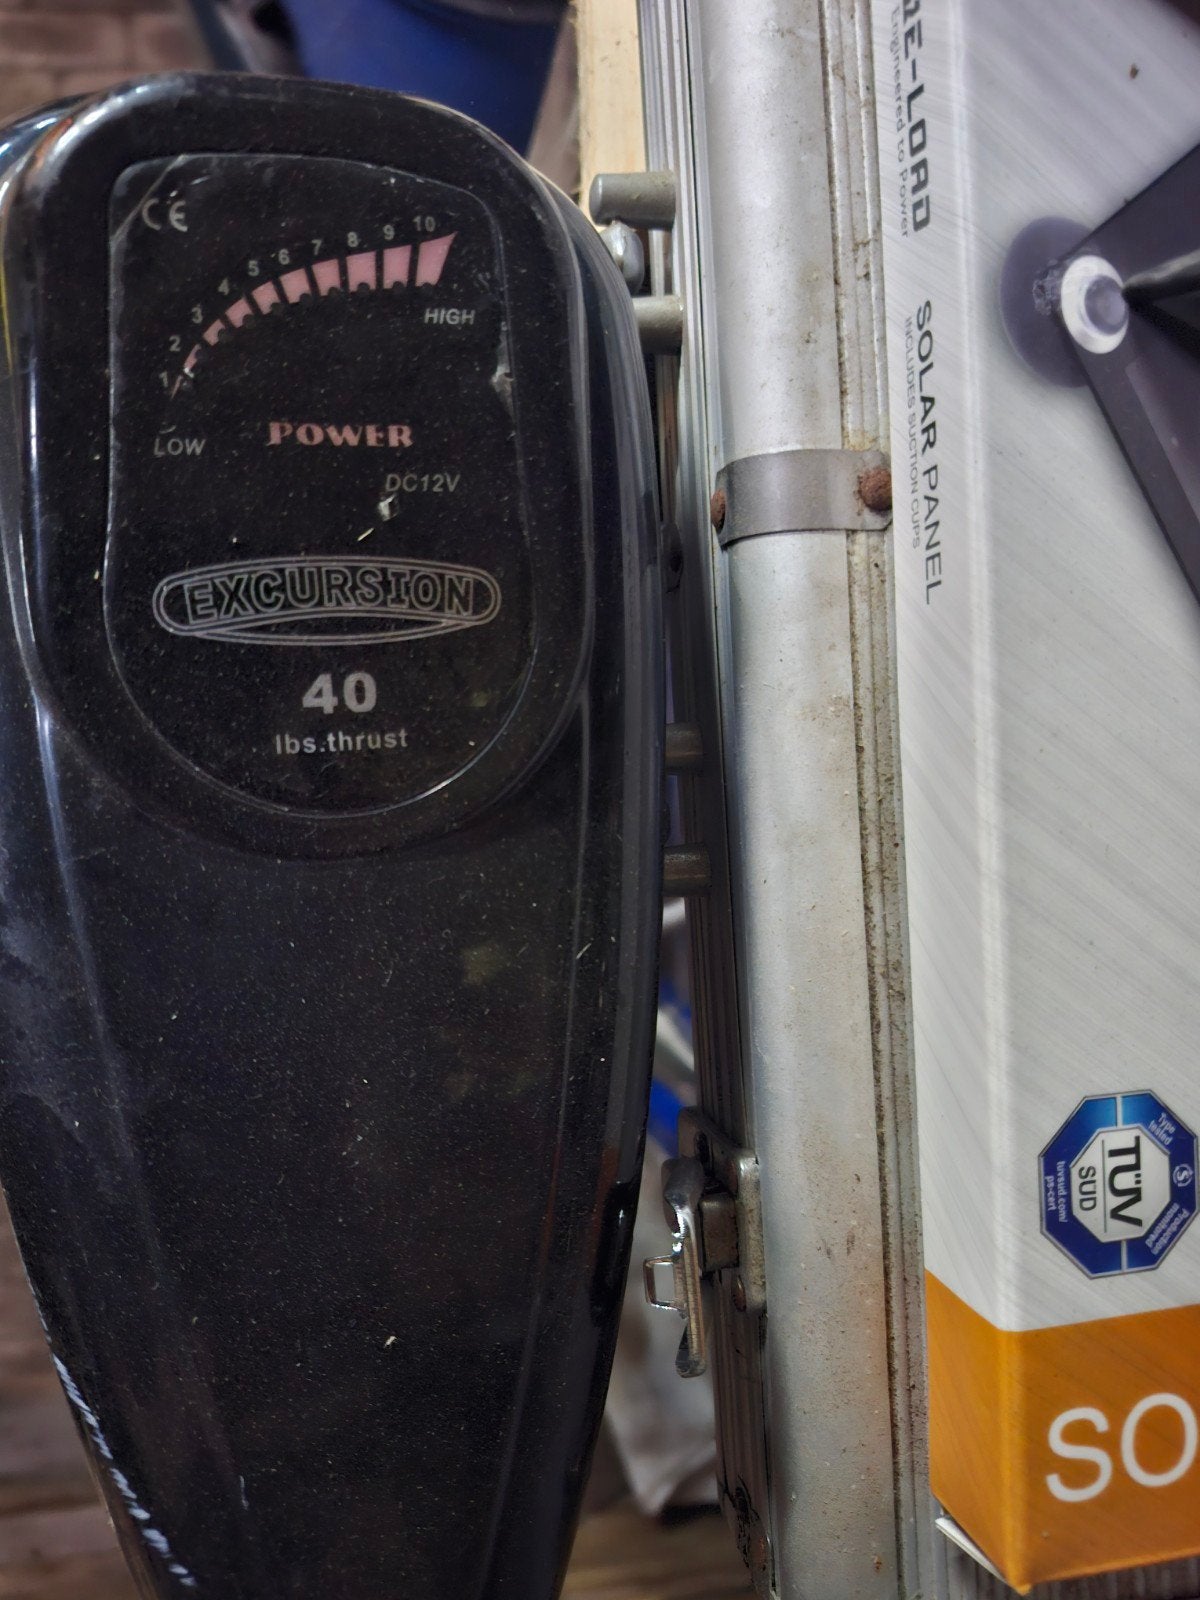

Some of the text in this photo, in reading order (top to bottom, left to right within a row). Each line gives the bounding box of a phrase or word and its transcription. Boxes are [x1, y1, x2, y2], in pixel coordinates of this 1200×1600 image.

[890, 6, 909, 237] Engineered to Power
[159, 215, 436, 387] 1 2 3 4 5 6 7 8 9 10
[424, 308, 475, 325] HIGH
[154, 437, 206, 456] LOW
[265, 421, 414, 448] POWER
[905, 316, 920, 549] INCLUDES SUCTION CUPS
[916, 300, 941, 605] SOLAR PANEL
[386, 473, 460, 493] DC12V
[183, 566, 474, 625] EXCURSION
[302, 672, 377, 715] 40
[1157, 1111, 1176, 1134] Type
[1107, 1135, 1143, 1228] TÜV
[1144, 1202, 1181, 1248] monitored
[1150, 1207, 1190, 1256] Production
[1045, 1391, 1198, 1503] SO
